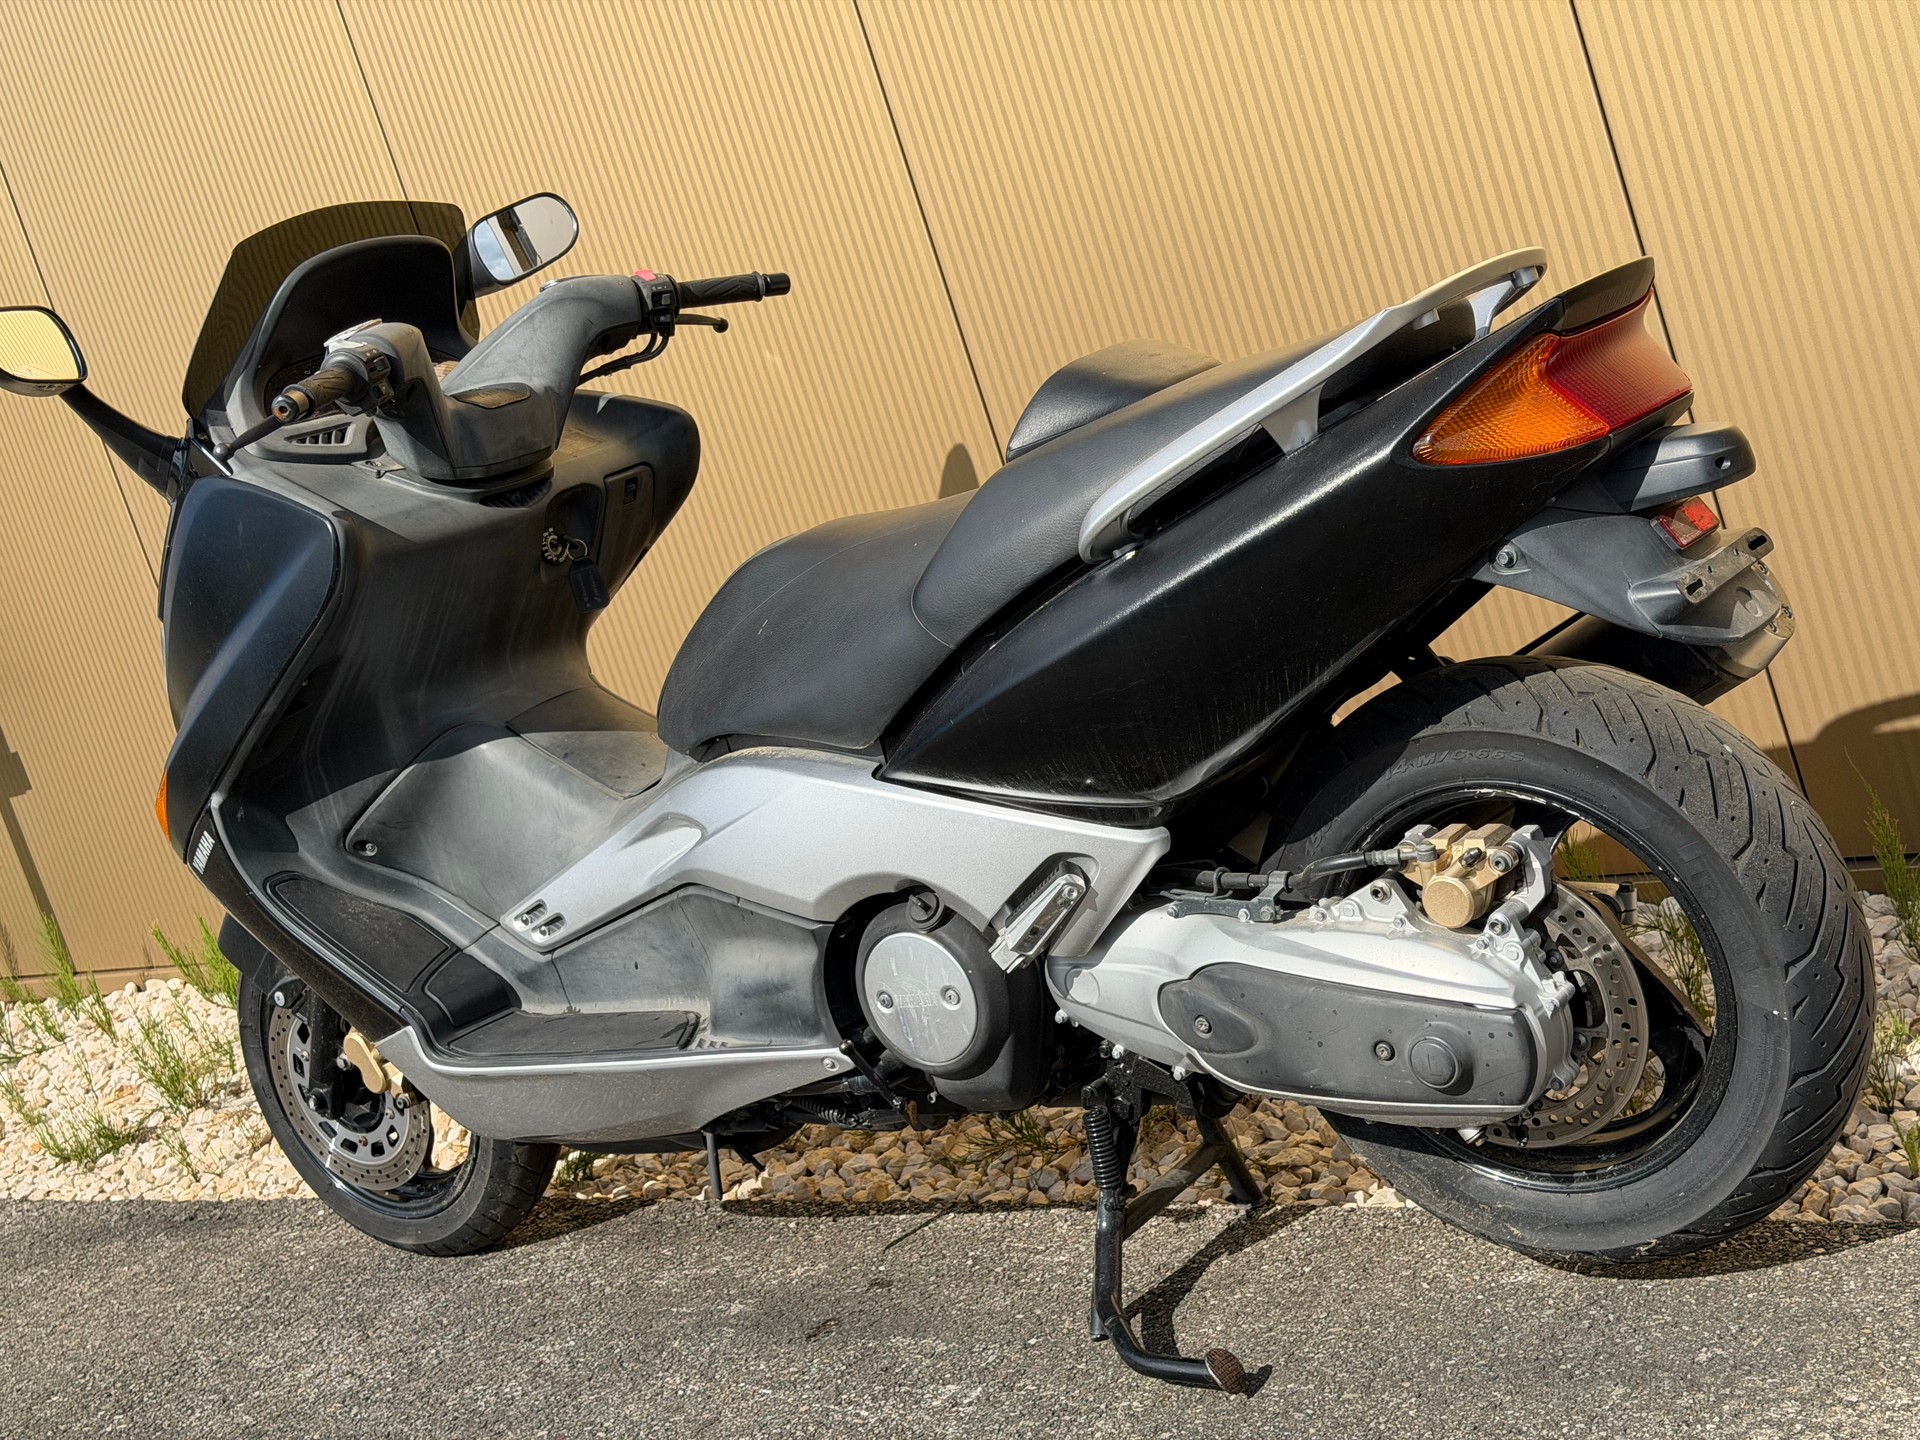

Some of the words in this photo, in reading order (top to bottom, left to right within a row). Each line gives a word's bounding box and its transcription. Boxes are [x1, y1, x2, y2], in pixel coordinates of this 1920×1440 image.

[1417, 748, 1469, 767] M/C
[1474, 748, 1526, 762] 66S
[192, 830, 216, 875] YAMAHA
[894, 992, 939, 1009] YAMAHA
